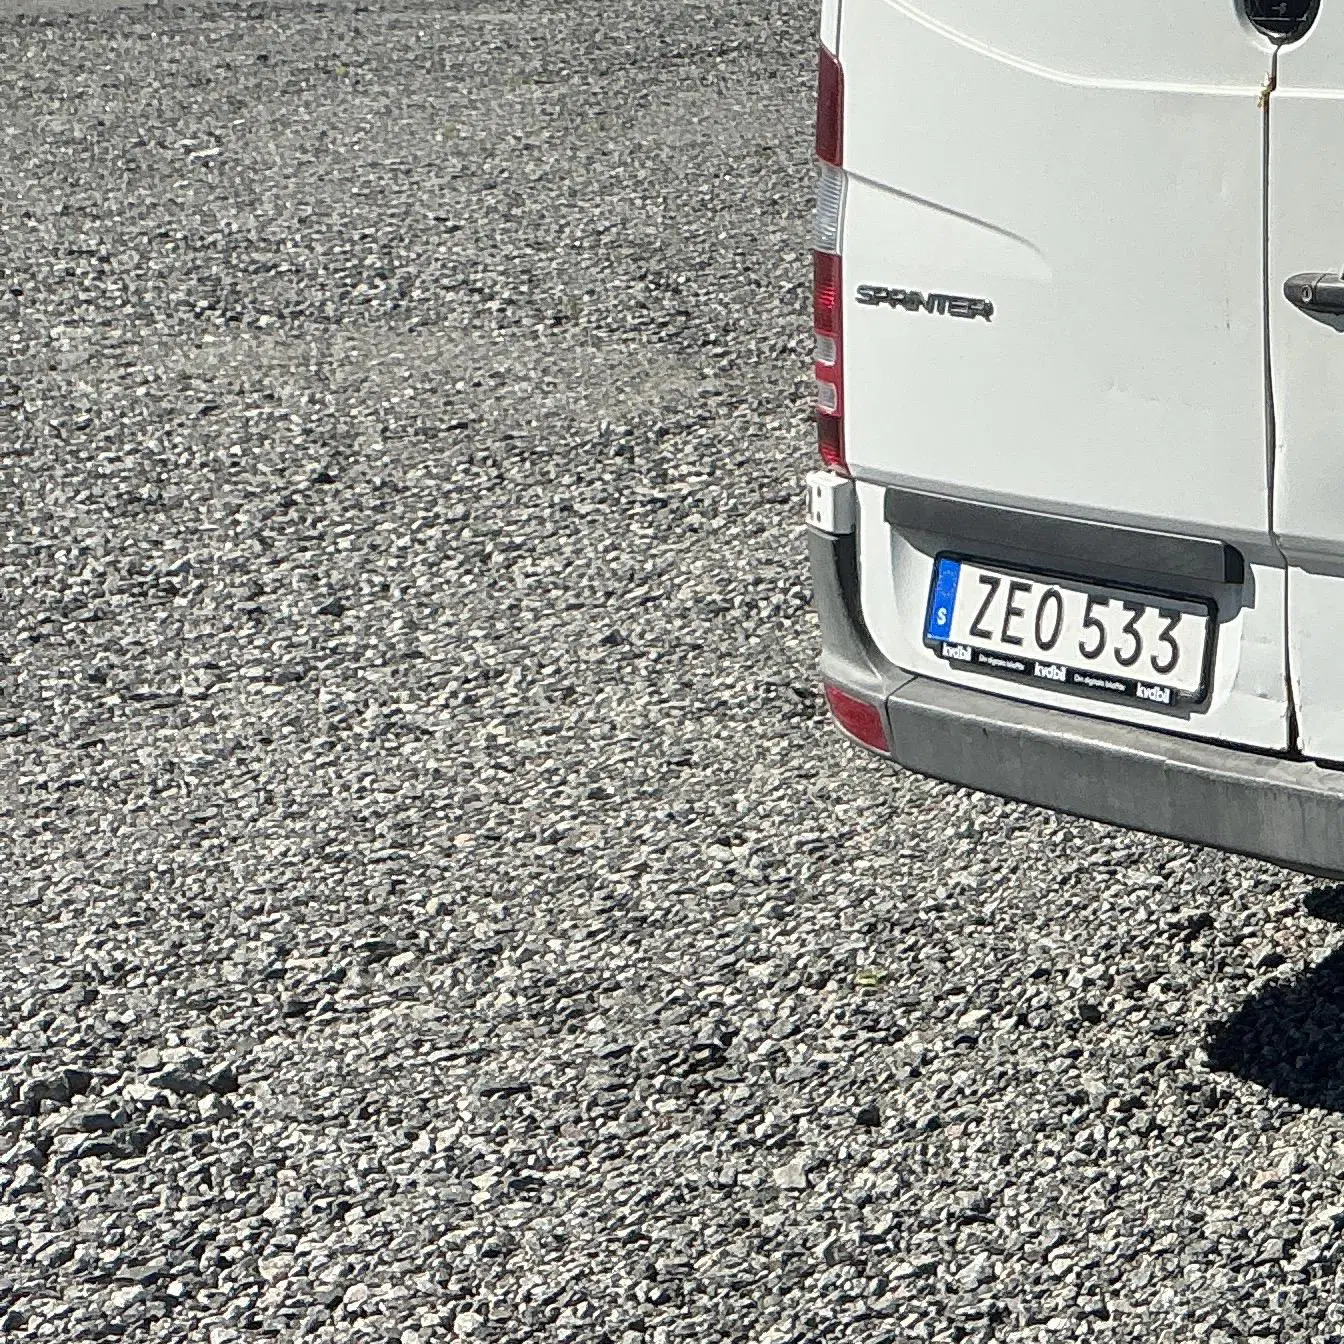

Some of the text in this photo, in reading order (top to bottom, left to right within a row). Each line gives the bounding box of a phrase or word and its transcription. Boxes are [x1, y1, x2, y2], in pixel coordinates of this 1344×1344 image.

[854, 284, 994, 323] SPRINTER
[936, 607, 947, 626] S
[969, 574, 1182, 674] ZEO 533
[1033, 661, 1068, 683] kvdbil
[1136, 681, 1171, 704] kvdbil
